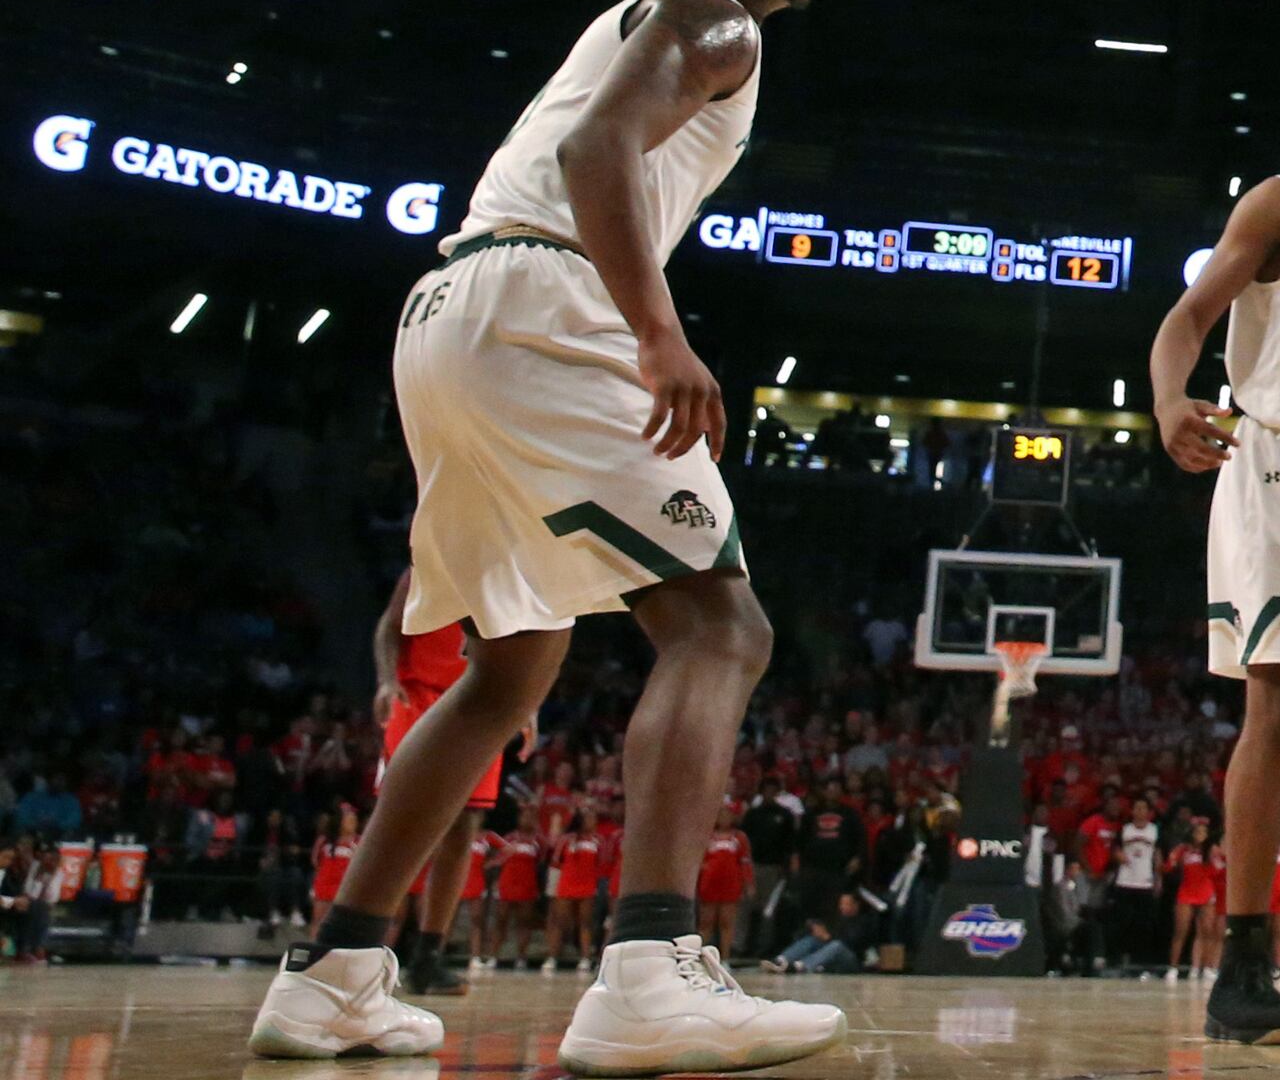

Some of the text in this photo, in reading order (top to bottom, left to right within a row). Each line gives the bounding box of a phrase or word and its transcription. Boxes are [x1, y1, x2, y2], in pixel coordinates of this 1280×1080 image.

[111, 136, 364, 219] GATORADE
[791, 234, 812, 259] 9
[844, 229, 877, 248] TOL
[934, 231, 987, 256] 3:09
[841, 249, 875, 267] FLS
[1017, 243, 1047, 261] TOL
[1015, 263, 1046, 281] FLS
[1067, 256, 1101, 282] 12
[980, 840, 1022, 858] PNC
